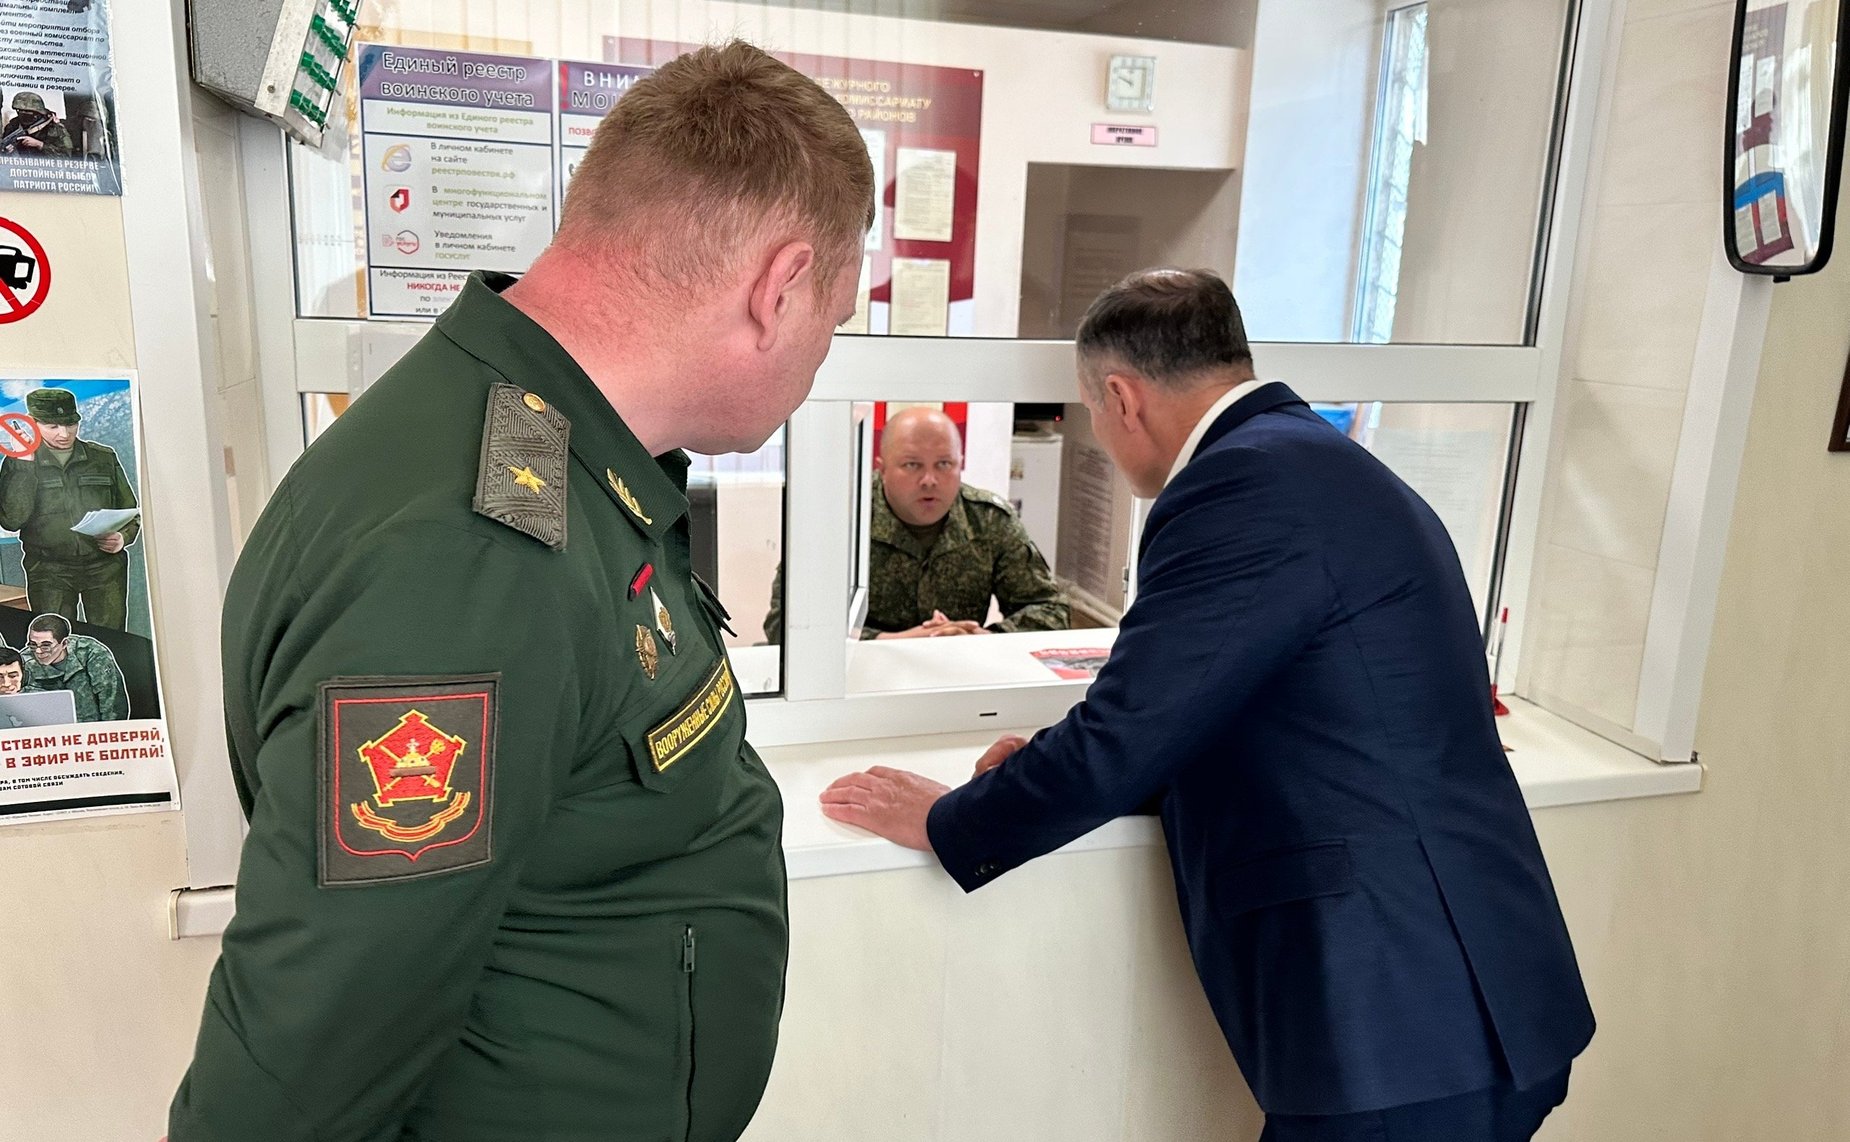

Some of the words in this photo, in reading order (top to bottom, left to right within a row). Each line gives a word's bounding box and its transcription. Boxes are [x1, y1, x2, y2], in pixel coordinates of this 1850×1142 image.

[18, 22, 70, 31] мероприятия
[44, 32, 94, 42] комиссариат
[33, 57, 68, 65] воинской
[383, 52, 458, 75] Единый
[463, 62, 527, 83] реестр
[36, 75, 75, 84] контракт
[381, 82, 479, 102] воинского
[484, 89, 535, 107] учета
[387, 107, 447, 119] Информация
[450, 112, 460, 120] из
[461, 113, 498, 124] Единого
[500, 117, 534, 126] реестра
[426, 122, 472, 132] воинского
[474, 125, 498, 134] учета
[431, 142, 437, 150] В
[438, 144, 472, 152] личном
[474, 145, 514, 155] кабинете
[0, 156, 55, 168] ПРЕБЫВАНИЕ
[57, 159, 62, 168] В
[64, 160, 99, 170] РЕЗЕРВЕ
[444, 155, 468, 164] сайте
[10, 168, 65, 181] ДОСТОЙНЫЙ
[66, 172, 97, 182] ВЫБОР
[14, 179, 57, 191] ПАТРИОТА
[432, 186, 438, 194] В
[432, 199, 464, 208] центре
[467, 200, 539, 212] государственных
[433, 210, 502, 222] муниципальных
[504, 214, 526, 223] услуг
[434, 230, 493, 241] Уведомления
[477, 243, 516, 253] кабинете
[380, 269, 435, 280] Информация
[407, 283, 448, 292] НИКОГДА
[450, 284, 461, 292] НЕ
[1, 736, 56, 751] СТВАМ
[62, 734, 82, 746] НЕ
[87, 727, 165, 745] ДОВЕРЯЙ,
[5, 757, 17, 769] В
[22, 753, 69, 768] ЭФИР
[75, 750, 95, 763] НЕ
[99, 744, 165, 761] БОЛТАЙ!
[13, 781, 41, 790] СОТОВОЙ
